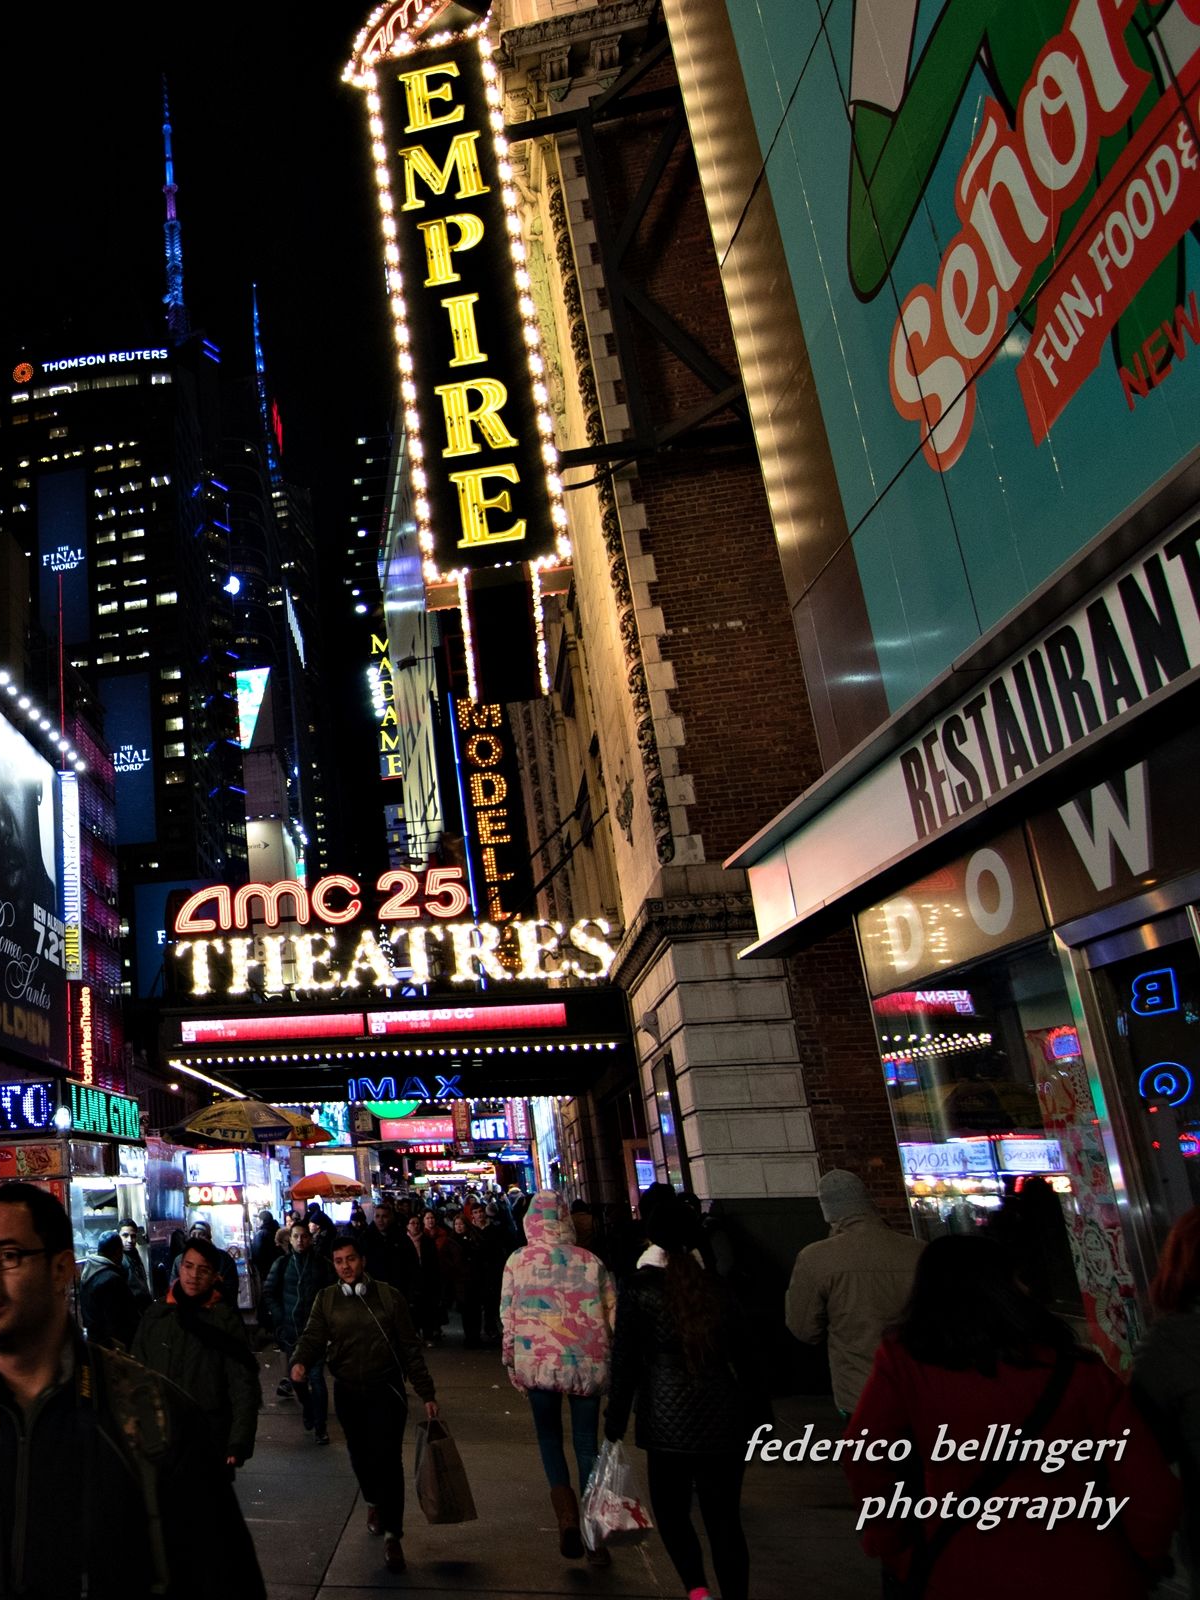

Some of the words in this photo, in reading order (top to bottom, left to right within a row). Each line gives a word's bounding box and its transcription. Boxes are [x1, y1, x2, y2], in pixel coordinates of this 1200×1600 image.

[1033, 274, 1103, 388] FUN,
[1088, 144, 1180, 293] FOOD
[397, 60, 528, 550] EMPIRE
[42, 355, 106, 373] THOMSON
[108, 349, 168, 363] REUTERS
[1120, 290, 1200, 413] NEW
[42, 549, 85, 567] FINAL
[57, 545, 69, 553] THE
[900, 518, 1200, 842] RESTAURANT
[113, 748, 150, 765] INAL
[120, 744, 133, 752] THE
[457, 698, 523, 966] MODELL
[174, 873, 362, 934] amc
[377, 866, 471, 921] 25
[33, 903, 46, 926] NEW
[33, 920, 66, 971] 7.21
[174, 915, 617, 996] THEATRES
[347, 1073, 466, 1100] IMAX
[471, 1118, 508, 1140] GIFT
[188, 1186, 238, 1203] SODA
